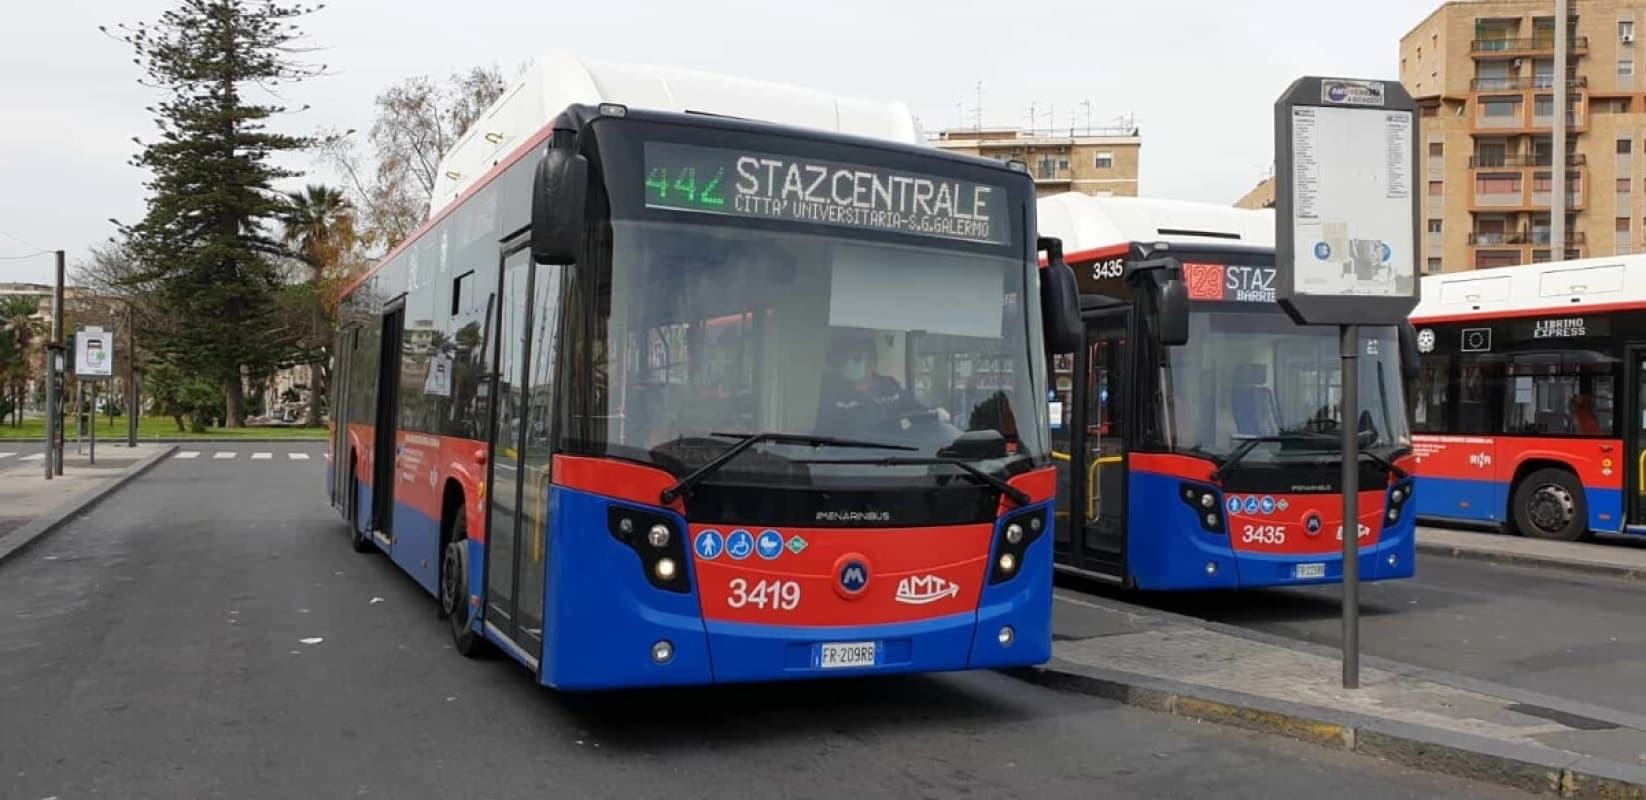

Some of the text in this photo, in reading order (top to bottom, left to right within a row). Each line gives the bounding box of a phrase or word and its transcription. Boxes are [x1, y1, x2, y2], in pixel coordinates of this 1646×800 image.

[1092, 259, 1123, 279] 3435
[1534, 327, 1586, 338] EXPRESS
[1242, 525, 1286, 544] 3435
[843, 567, 864, 585] M
[727, 578, 801, 610] 3419
[896, 575, 951, 600] AMT
